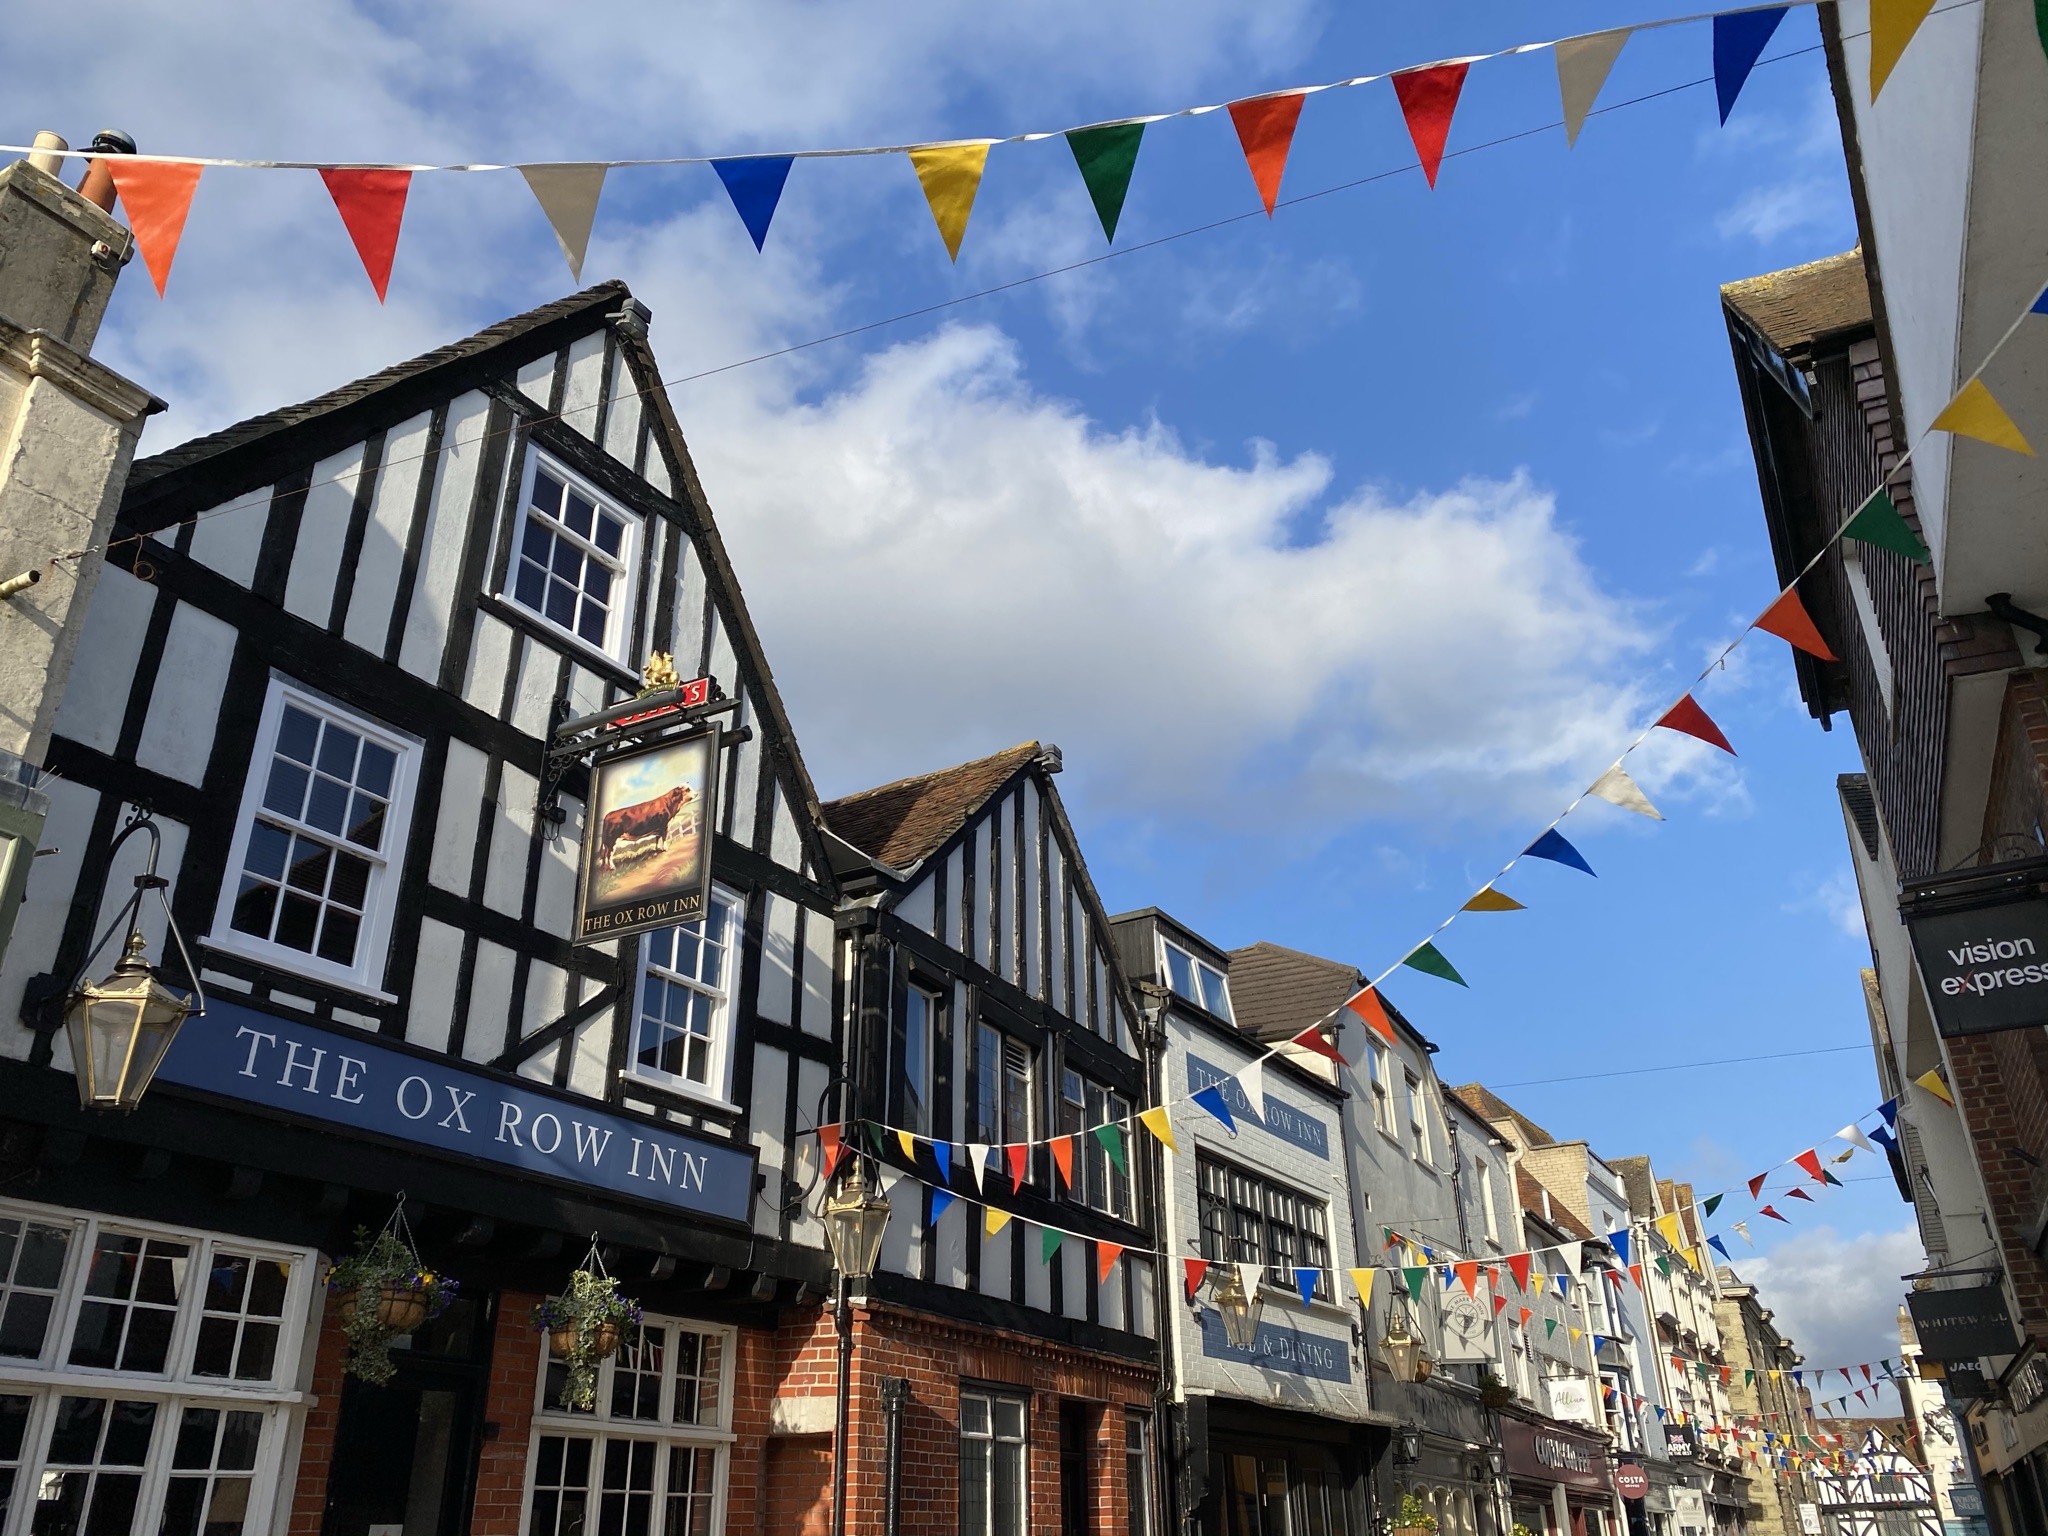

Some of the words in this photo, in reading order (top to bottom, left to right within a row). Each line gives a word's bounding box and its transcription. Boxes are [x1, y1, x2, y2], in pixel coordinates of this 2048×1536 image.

[585, 914, 611, 931] THE
[614, 909, 634, 925] OX
[637, 901, 670, 920] ROW
[673, 895, 700, 912] INN
[1947, 937, 2036, 966] vision
[236, 1025, 367, 1104] THE
[396, 1076, 476, 1133] OX
[494, 1101, 613, 1167] ROW
[627, 1137, 708, 1193] INN
[1263, 1101, 1292, 1132] ROW
[1296, 1118, 1321, 1146] INN
[1263, 1334, 1275, 1357] &
[1279, 1337, 1333, 1369] DINING
[1667, 1443, 1691, 1452] ARMY
[1618, 1476, 1645, 1484] COSTA
